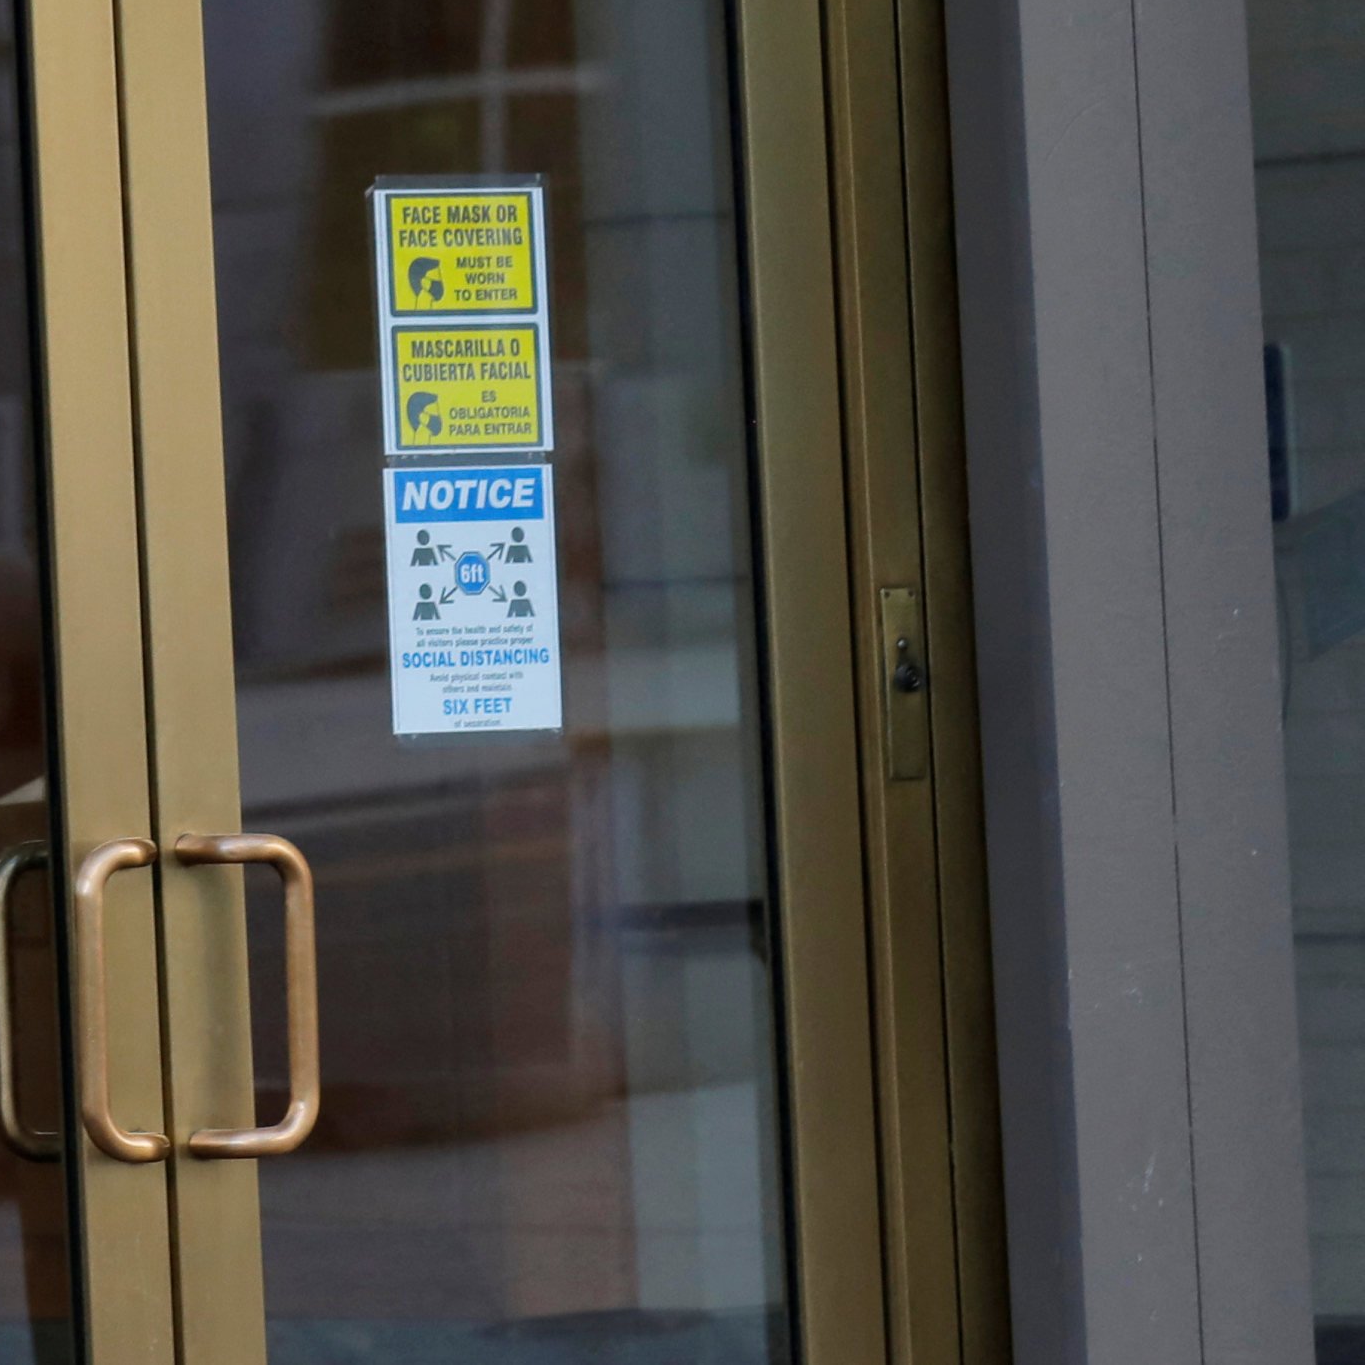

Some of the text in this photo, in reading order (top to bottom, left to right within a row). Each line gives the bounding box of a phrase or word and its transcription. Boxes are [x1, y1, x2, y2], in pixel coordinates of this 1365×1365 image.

[402, 205, 517, 224] FACE MASK OR
[399, 228, 523, 247] FACE COVERING
[456, 256, 513, 268] MUST BE
[466, 273, 504, 284] WORN
[454, 289, 517, 301] TO ENTER
[411, 339, 520, 358] MASCARILLA O
[403, 362, 531, 382] CUBIERTA FACIAL
[482, 390, 496, 402] ES
[449, 407, 530, 419] OBLIGATORIA
[449, 423, 532, 436] PARA ENTRAR
[401, 478, 535, 510] NOTICE
[460, 565, 484, 583] 6ft
[402, 648, 550, 668] SOCIAL DISTANCING
[443, 697, 512, 715] SIX FEET
